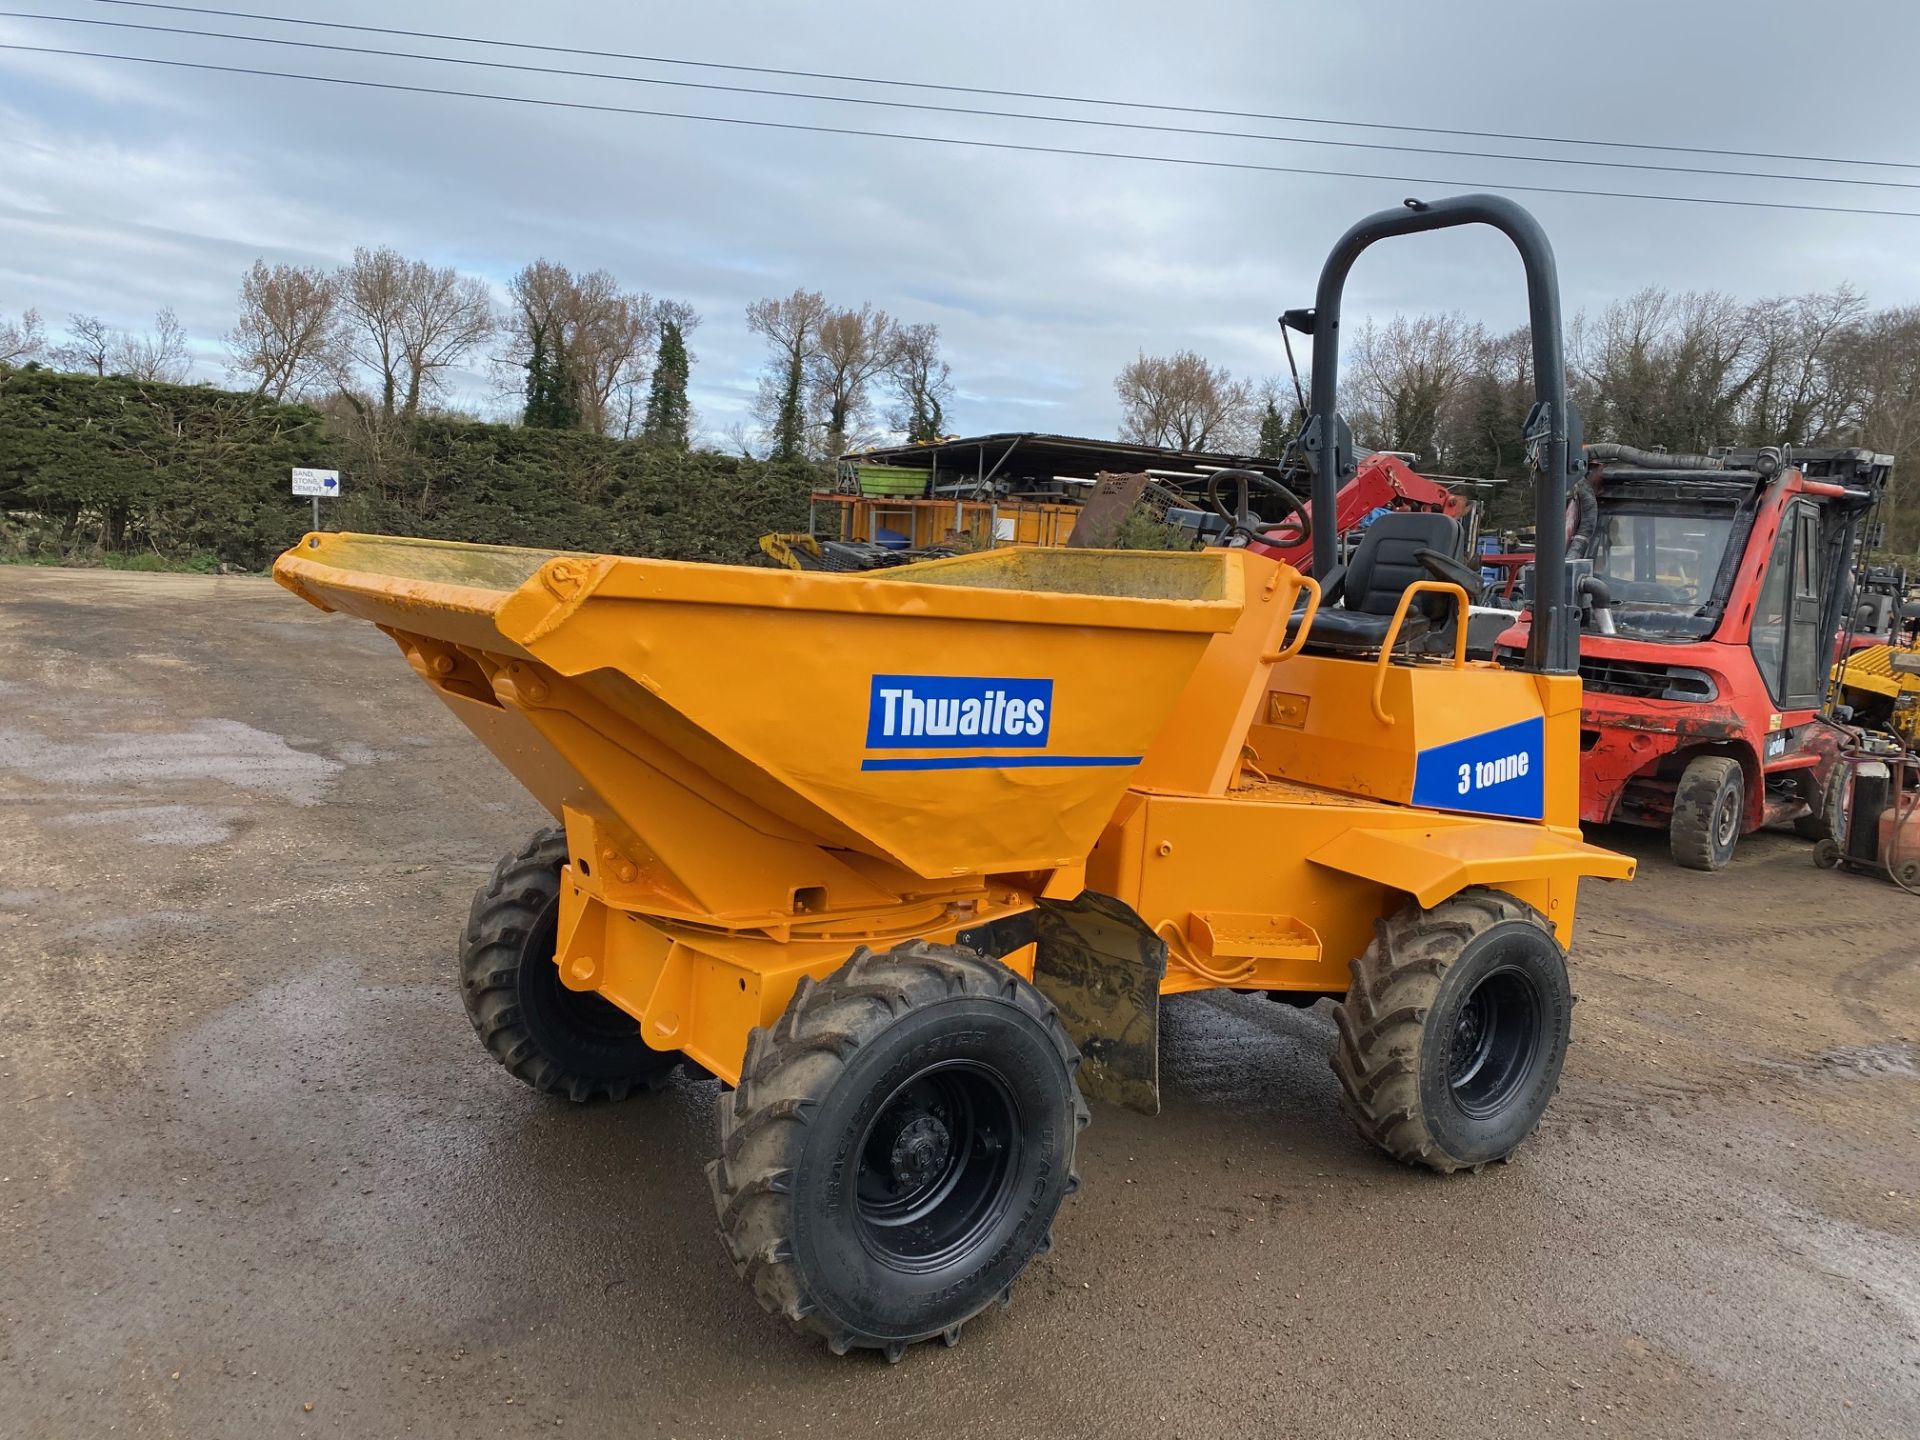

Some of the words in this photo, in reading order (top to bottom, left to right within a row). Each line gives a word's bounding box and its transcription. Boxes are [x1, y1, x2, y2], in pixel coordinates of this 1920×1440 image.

[880, 689, 1045, 736] Thwaites
[1458, 763, 1471, 795] 3
[1476, 751, 1529, 790] tonne
